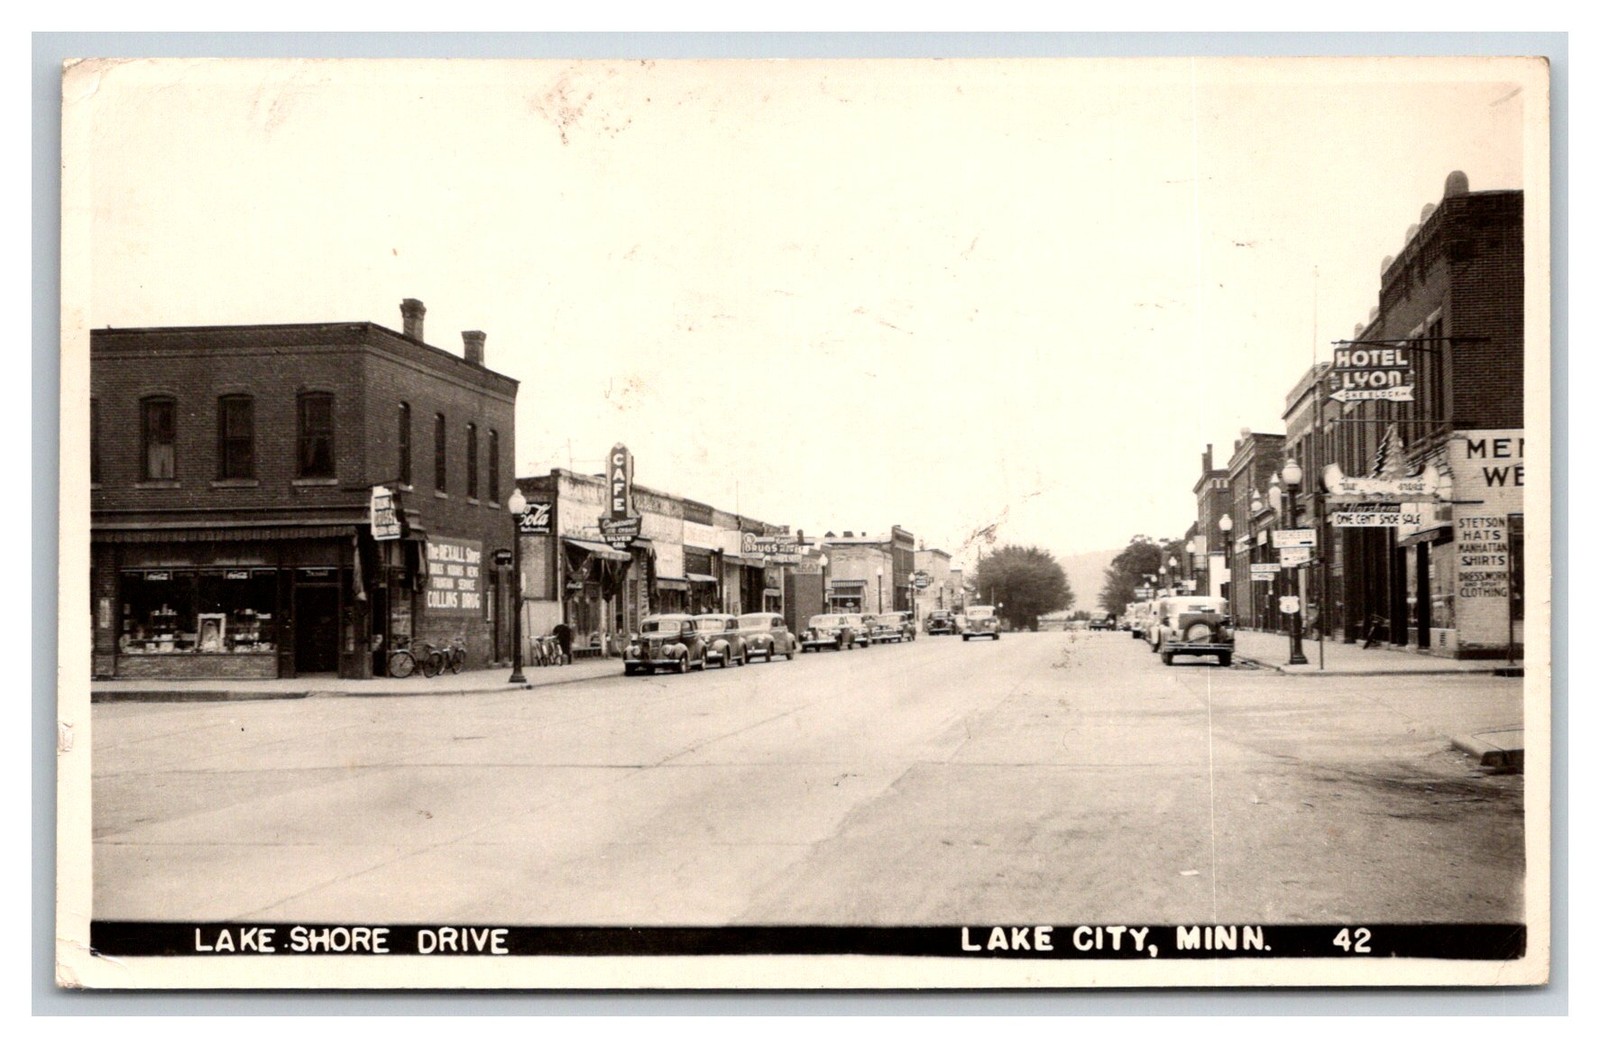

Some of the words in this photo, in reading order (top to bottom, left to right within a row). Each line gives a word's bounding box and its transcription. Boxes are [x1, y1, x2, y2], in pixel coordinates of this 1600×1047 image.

[1336, 349, 1408, 367] HOTEL
[1343, 370, 1402, 388] LYON
[1467, 438, 1524, 459] ME
[612, 453, 625, 512] CAFE
[1337, 514, 1354, 525] ONE
[1356, 514, 1376, 525] CENT
[1380, 514, 1399, 525] SHOE
[1402, 514, 1422, 525] SALE
[1458, 517, 1505, 529] STETSON
[1463, 530, 1501, 541] HATS
[745, 544, 778, 553] DRUGS
[1458, 543, 1508, 553] MANHATTAN
[1461, 555, 1506, 566] SHIRTS
[1460, 587, 1507, 598] CLOTHING
[427, 590, 458, 608] COLLINS
[461, 592, 480, 609] DRUG
